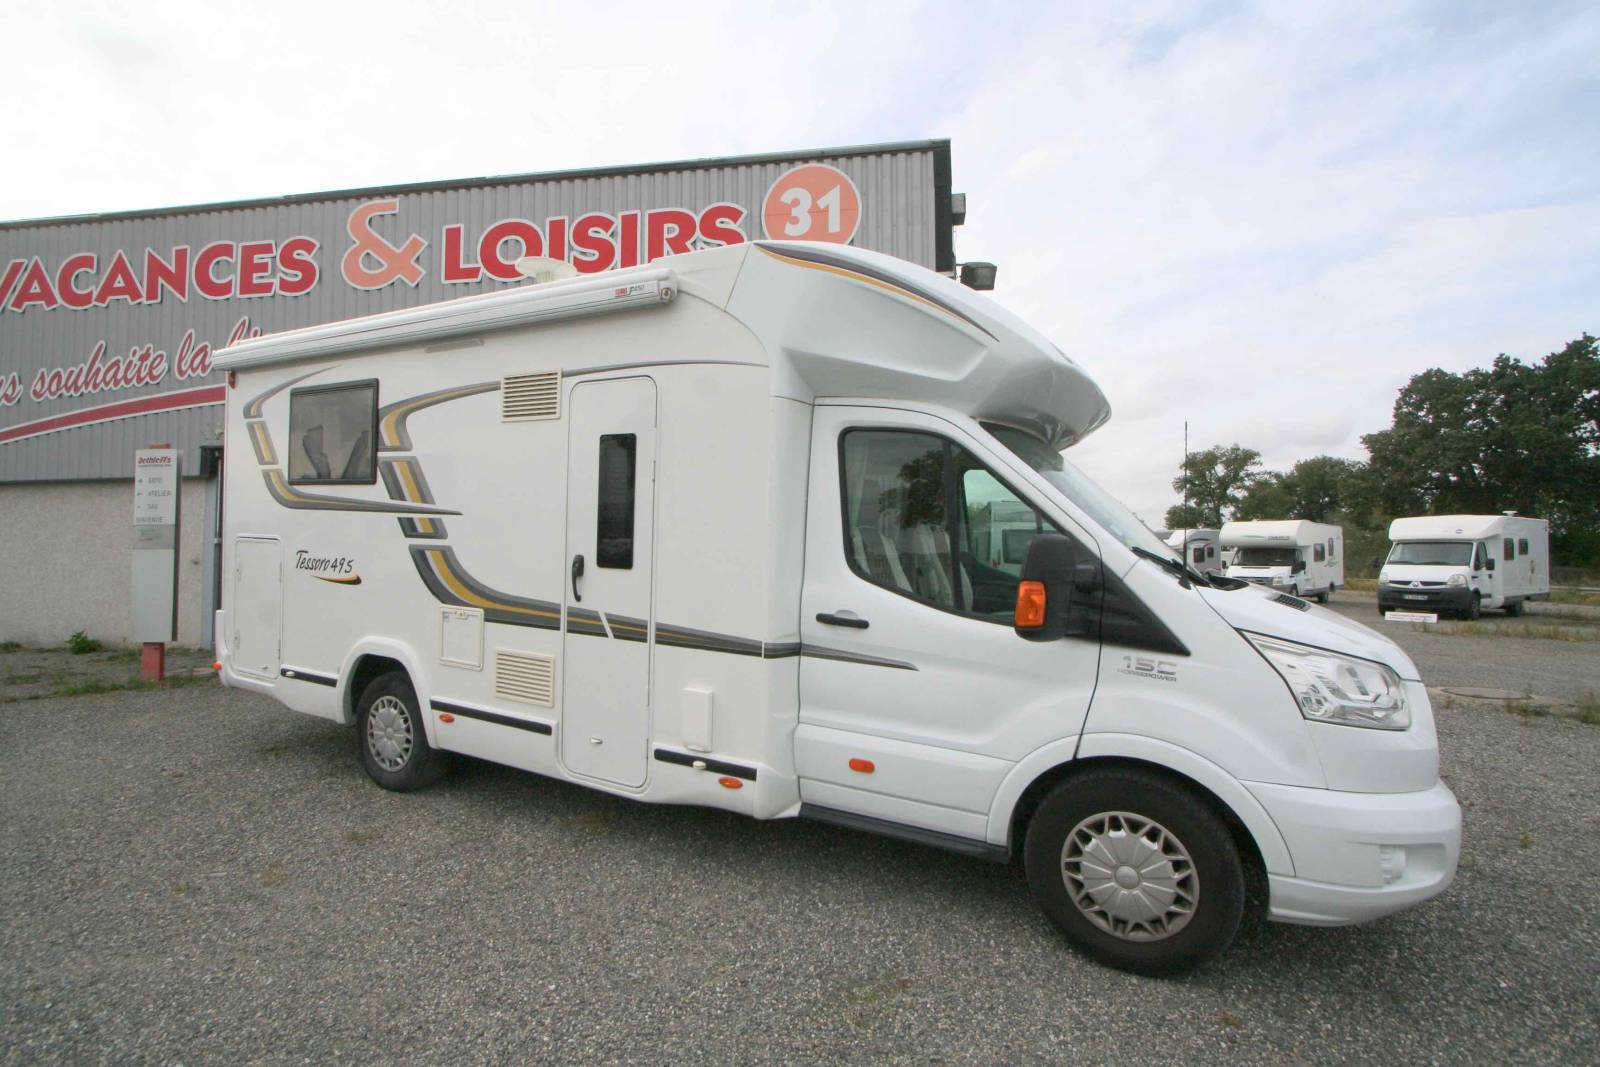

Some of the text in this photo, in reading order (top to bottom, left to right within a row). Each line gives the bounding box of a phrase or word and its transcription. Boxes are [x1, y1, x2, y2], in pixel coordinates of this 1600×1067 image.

[0, 184, 842, 312] VACANCES & LOISIRS 31
[31, 340, 168, 401] souhaite
[174, 328, 214, 381] la
[330, 557, 354, 574] 495
